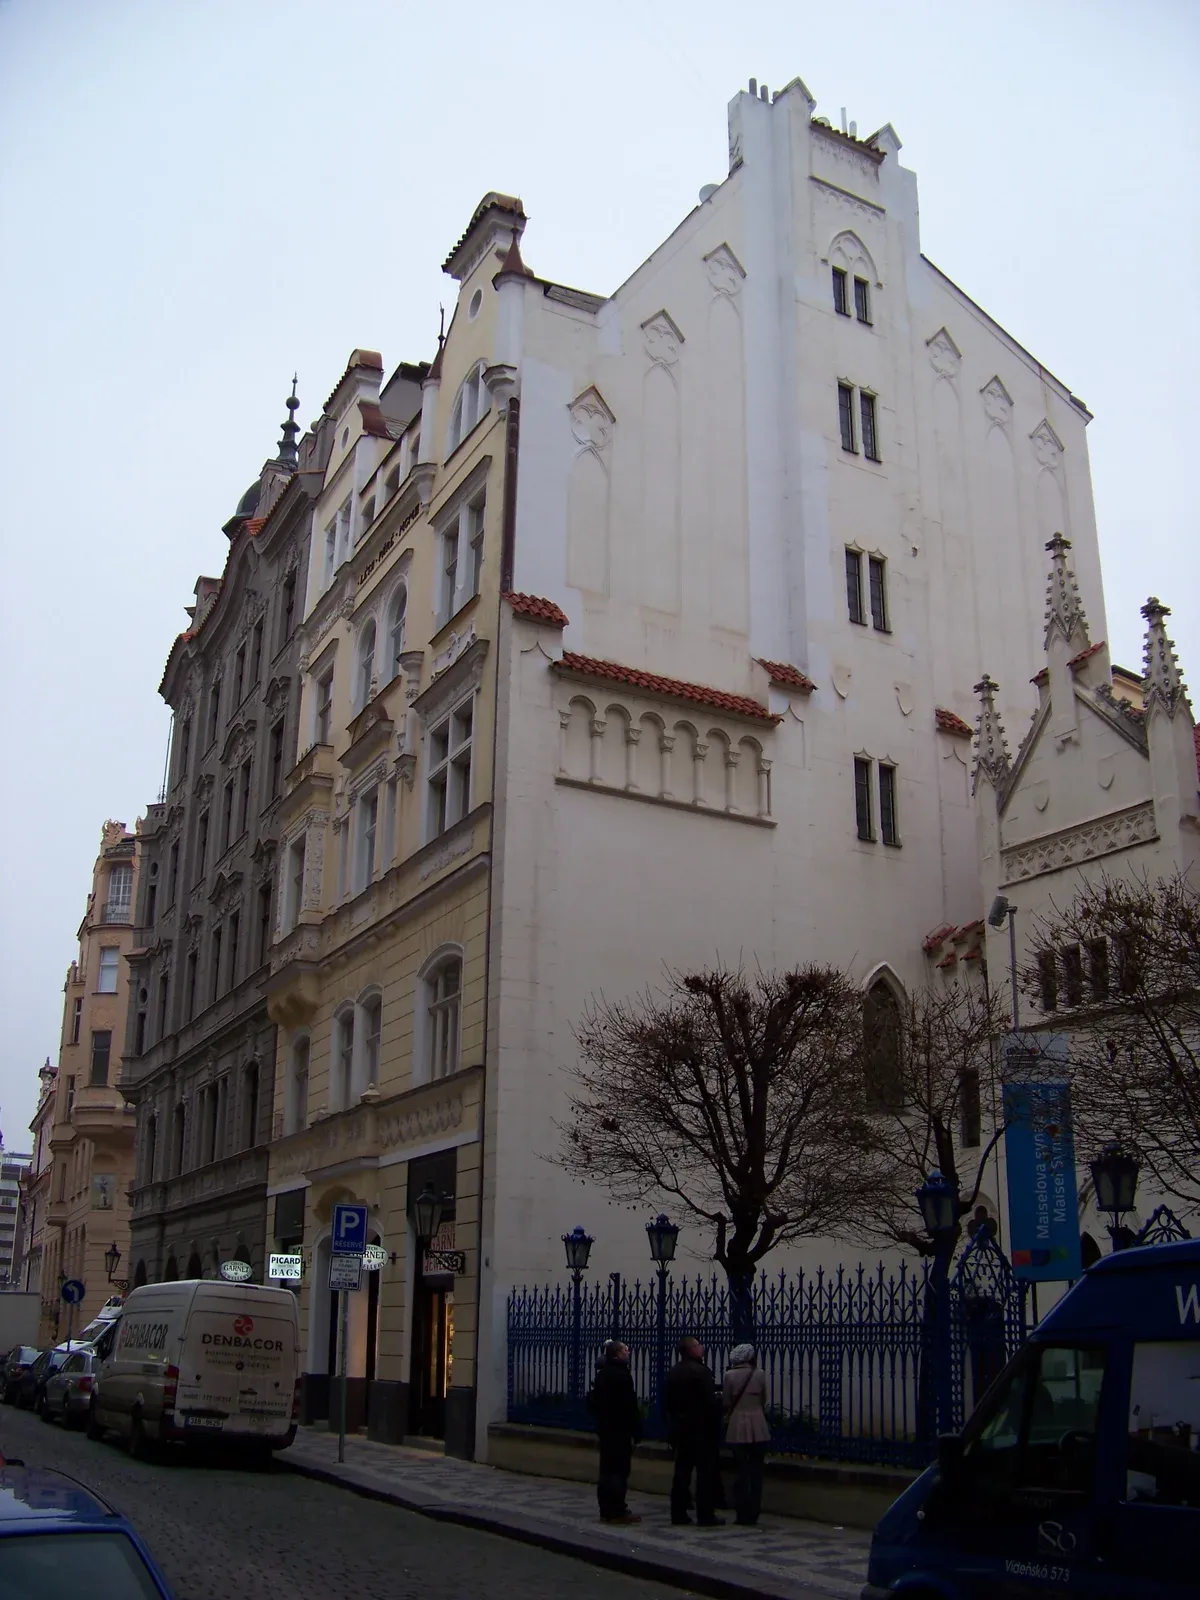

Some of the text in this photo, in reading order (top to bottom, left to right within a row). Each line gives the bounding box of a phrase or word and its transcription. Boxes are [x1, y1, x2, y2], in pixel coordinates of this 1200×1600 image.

[1036, 1163, 1050, 1240] Maiselova
[1053, 1175, 1067, 1223] Maisel
[340, 1211, 360, 1238] P
[223, 1264, 250, 1273] GARNET
[271, 1256, 301, 1265] PICARD
[123, 1323, 169, 1350] DENBACOR
[202, 1333, 283, 1351] DENBACOR
[1050, 1565, 1071, 1583] 573
